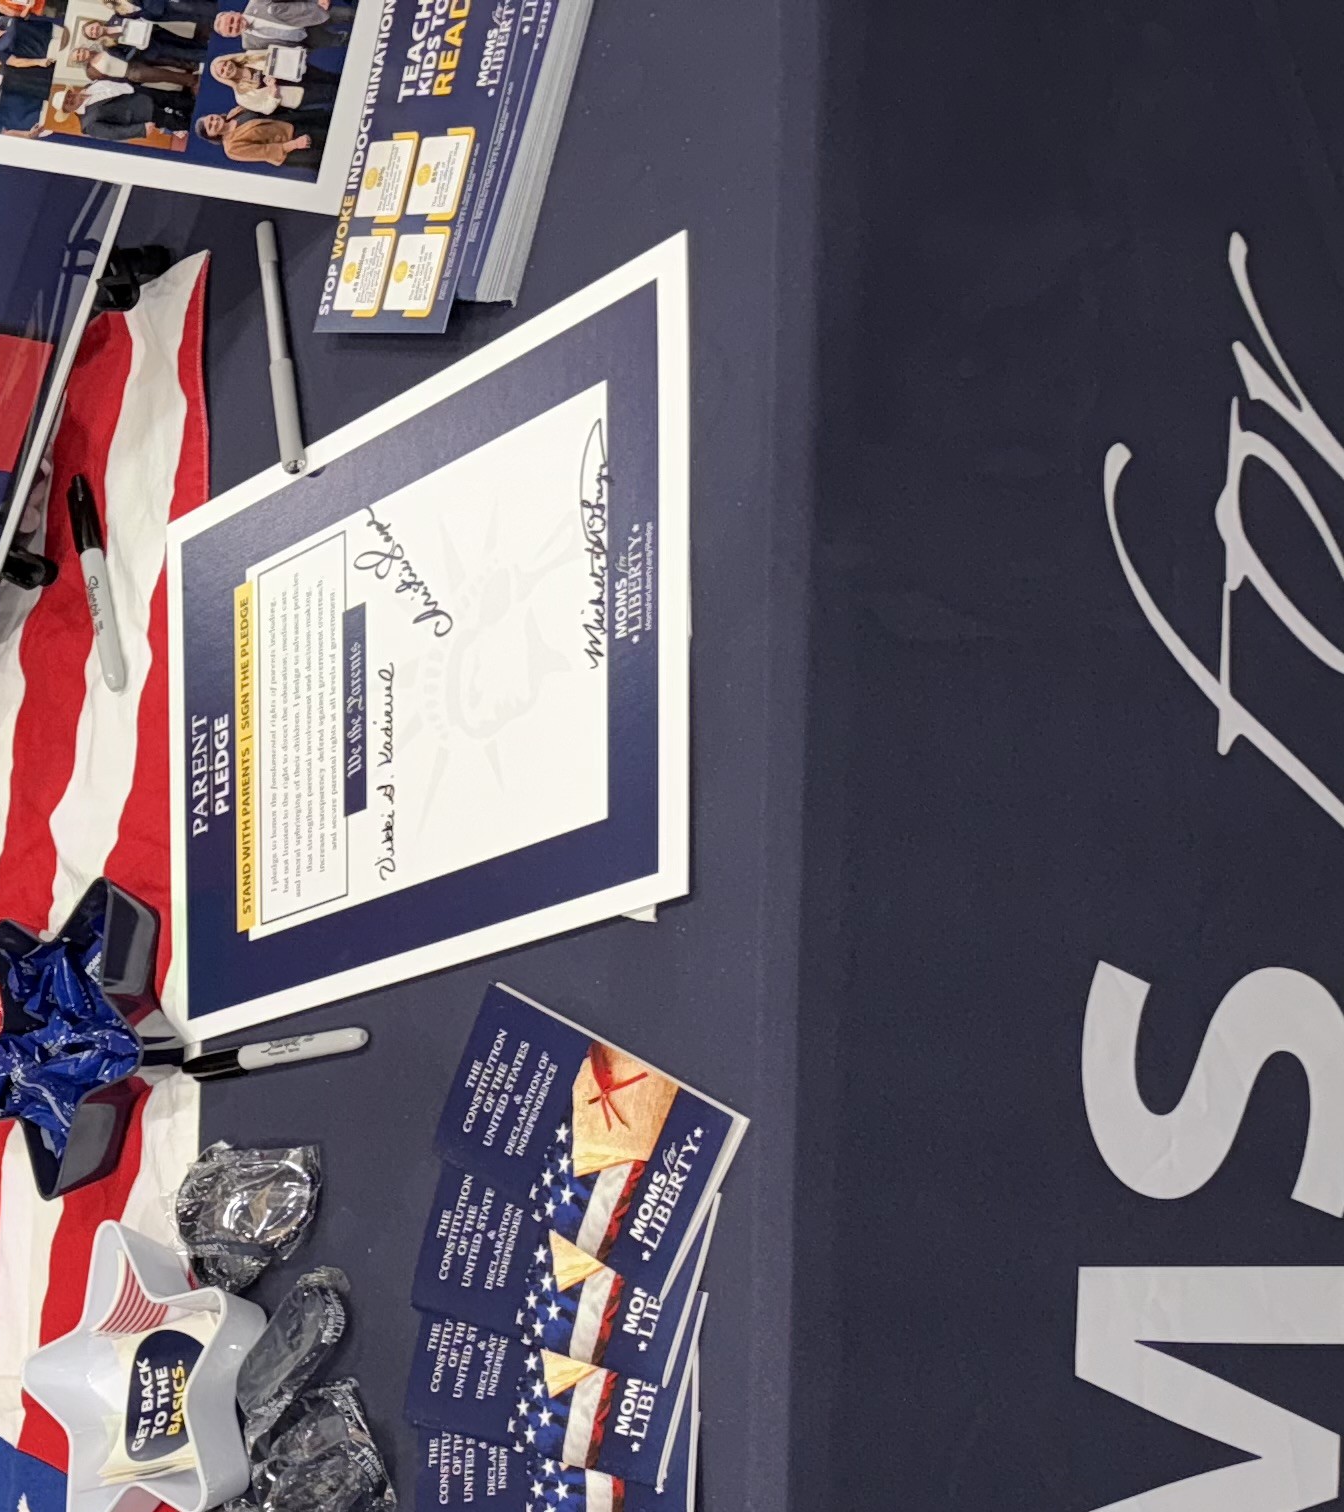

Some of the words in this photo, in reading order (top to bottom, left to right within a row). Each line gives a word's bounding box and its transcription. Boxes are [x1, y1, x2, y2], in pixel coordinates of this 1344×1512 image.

[415, 35, 442, 96] KIDS
[475, 27, 499, 87] MOMS
[318, 263, 340, 316] STOP
[330, 194, 356, 260] WOKE
[614, 577, 628, 639] MOMS
[628, 533, 643, 633] LIBERTY
[239, 597, 250, 656] PLEDGE
[240, 660, 250, 687] THE
[346, 641, 365, 713] Parents
[240, 692, 250, 730] SIGN
[346, 715, 363, 741] the
[191, 715, 209, 837] PARENT
[214, 714, 230, 815] PLEDGE
[240, 747, 251, 816] PARENTS
[346, 745, 363, 778] We
[241, 820, 251, 860] WITH
[241, 863, 252, 914] STAND
[462, 1028, 508, 1133] CONSTITUTION
[464, 1060, 483, 1088] THE
[482, 1093, 509, 1147] UNITED
[503, 1040, 530, 1093] STATES
[483, 1092, 495, 1113] OF
[490, 1062, 509, 1091] THE
[504, 1070, 543, 1157] DECLARATION
[537, 1051, 550, 1070] OF
[513, 1094, 523, 1105] &
[515, 1062, 558, 1157] INDEPENDENCE
[462, 1204, 478, 1233] THE
[628, 1171, 668, 1241] MOMS
[662, 1142, 678, 1178] for
[641, 1132, 702, 1251] LIBERTY
[436, 1209, 452, 1238] THE
[438, 1174, 473, 1281] CONSTITUTION
[457, 1235, 469, 1256] OF
[461, 1233, 483, 1287] UNITED
[476, 1186, 495, 1231] STATE
[484, 1202, 514, 1290] DECLARATION
[136, 1357, 155, 1413] BACK
[155, 1366, 170, 1408] THE
[166, 1359, 186, 1436] BASICS.
[130, 1417, 152, 1452] GET
[150, 1410, 169, 1439] TO
